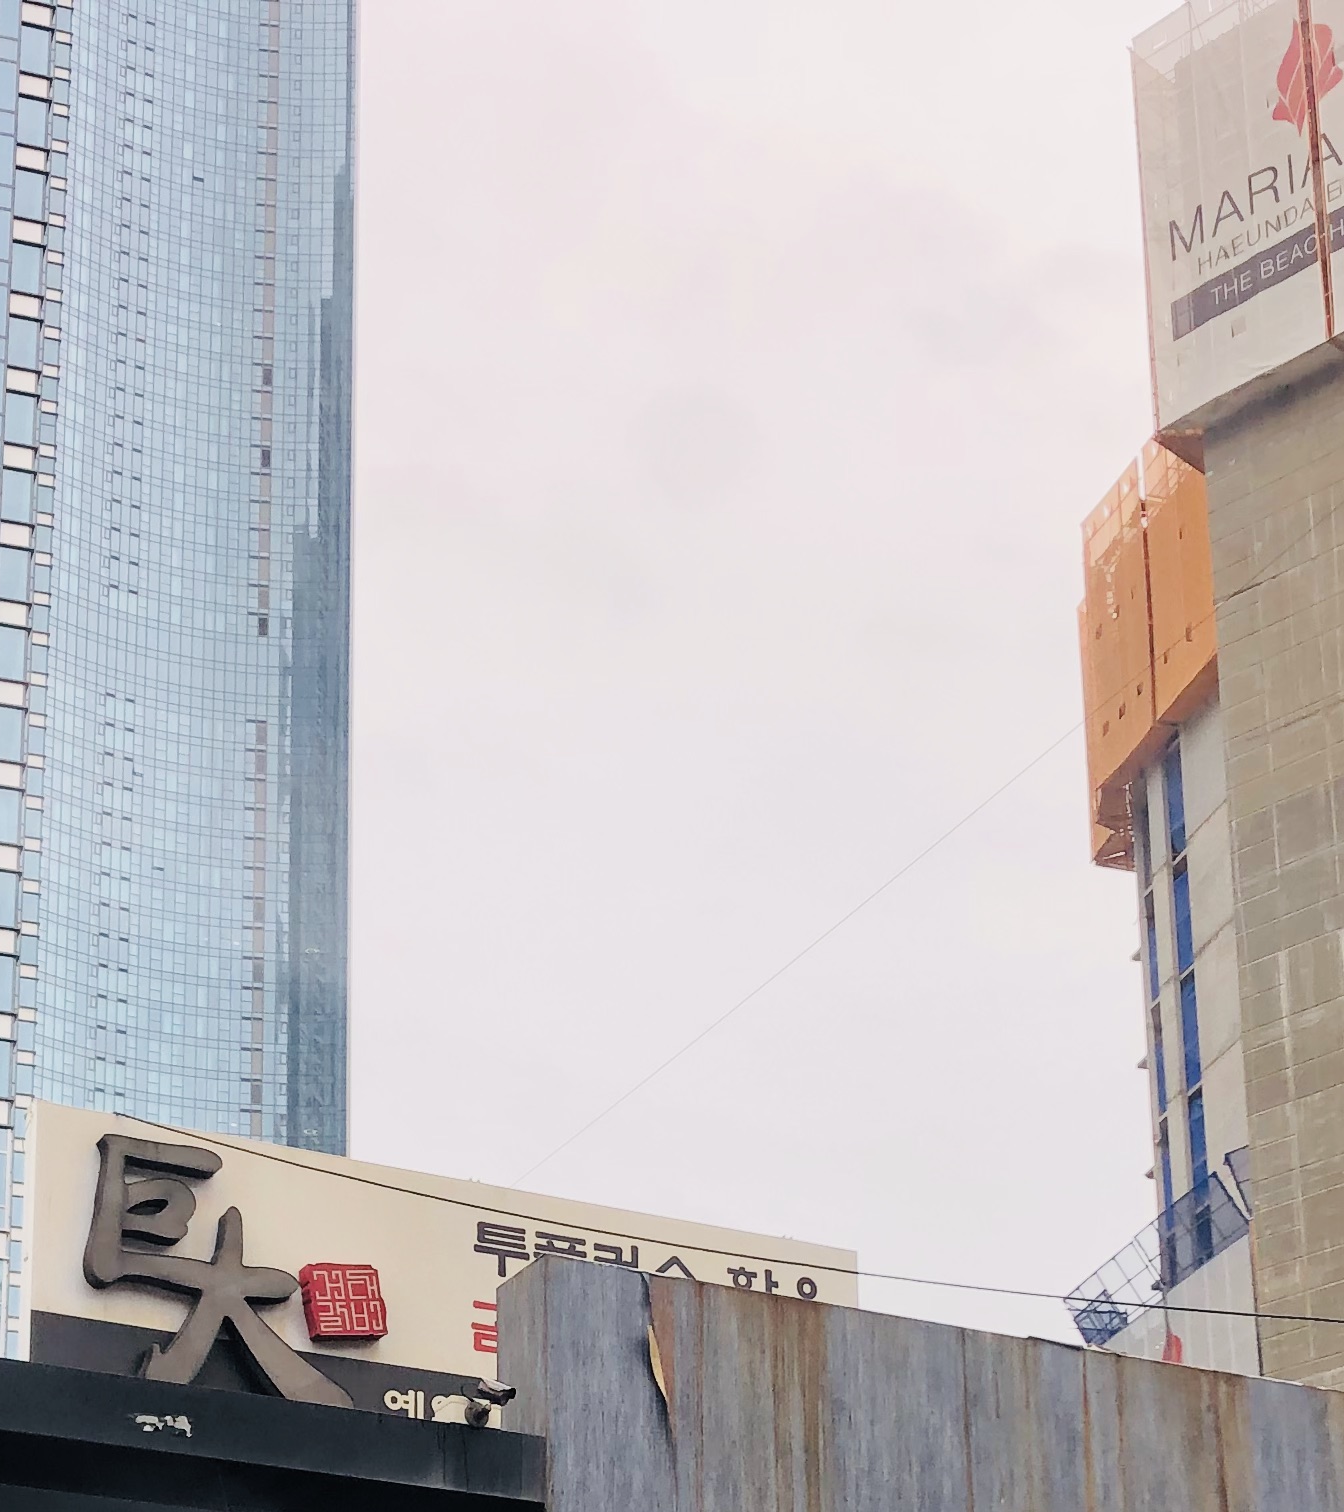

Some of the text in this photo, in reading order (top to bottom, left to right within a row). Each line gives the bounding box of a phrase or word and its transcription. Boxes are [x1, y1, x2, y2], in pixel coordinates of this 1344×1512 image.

[1198, 180, 1342, 275] HAEUNDAE
[1210, 270, 1254, 305] THE
[1260, 218, 1344, 279] BEACH
